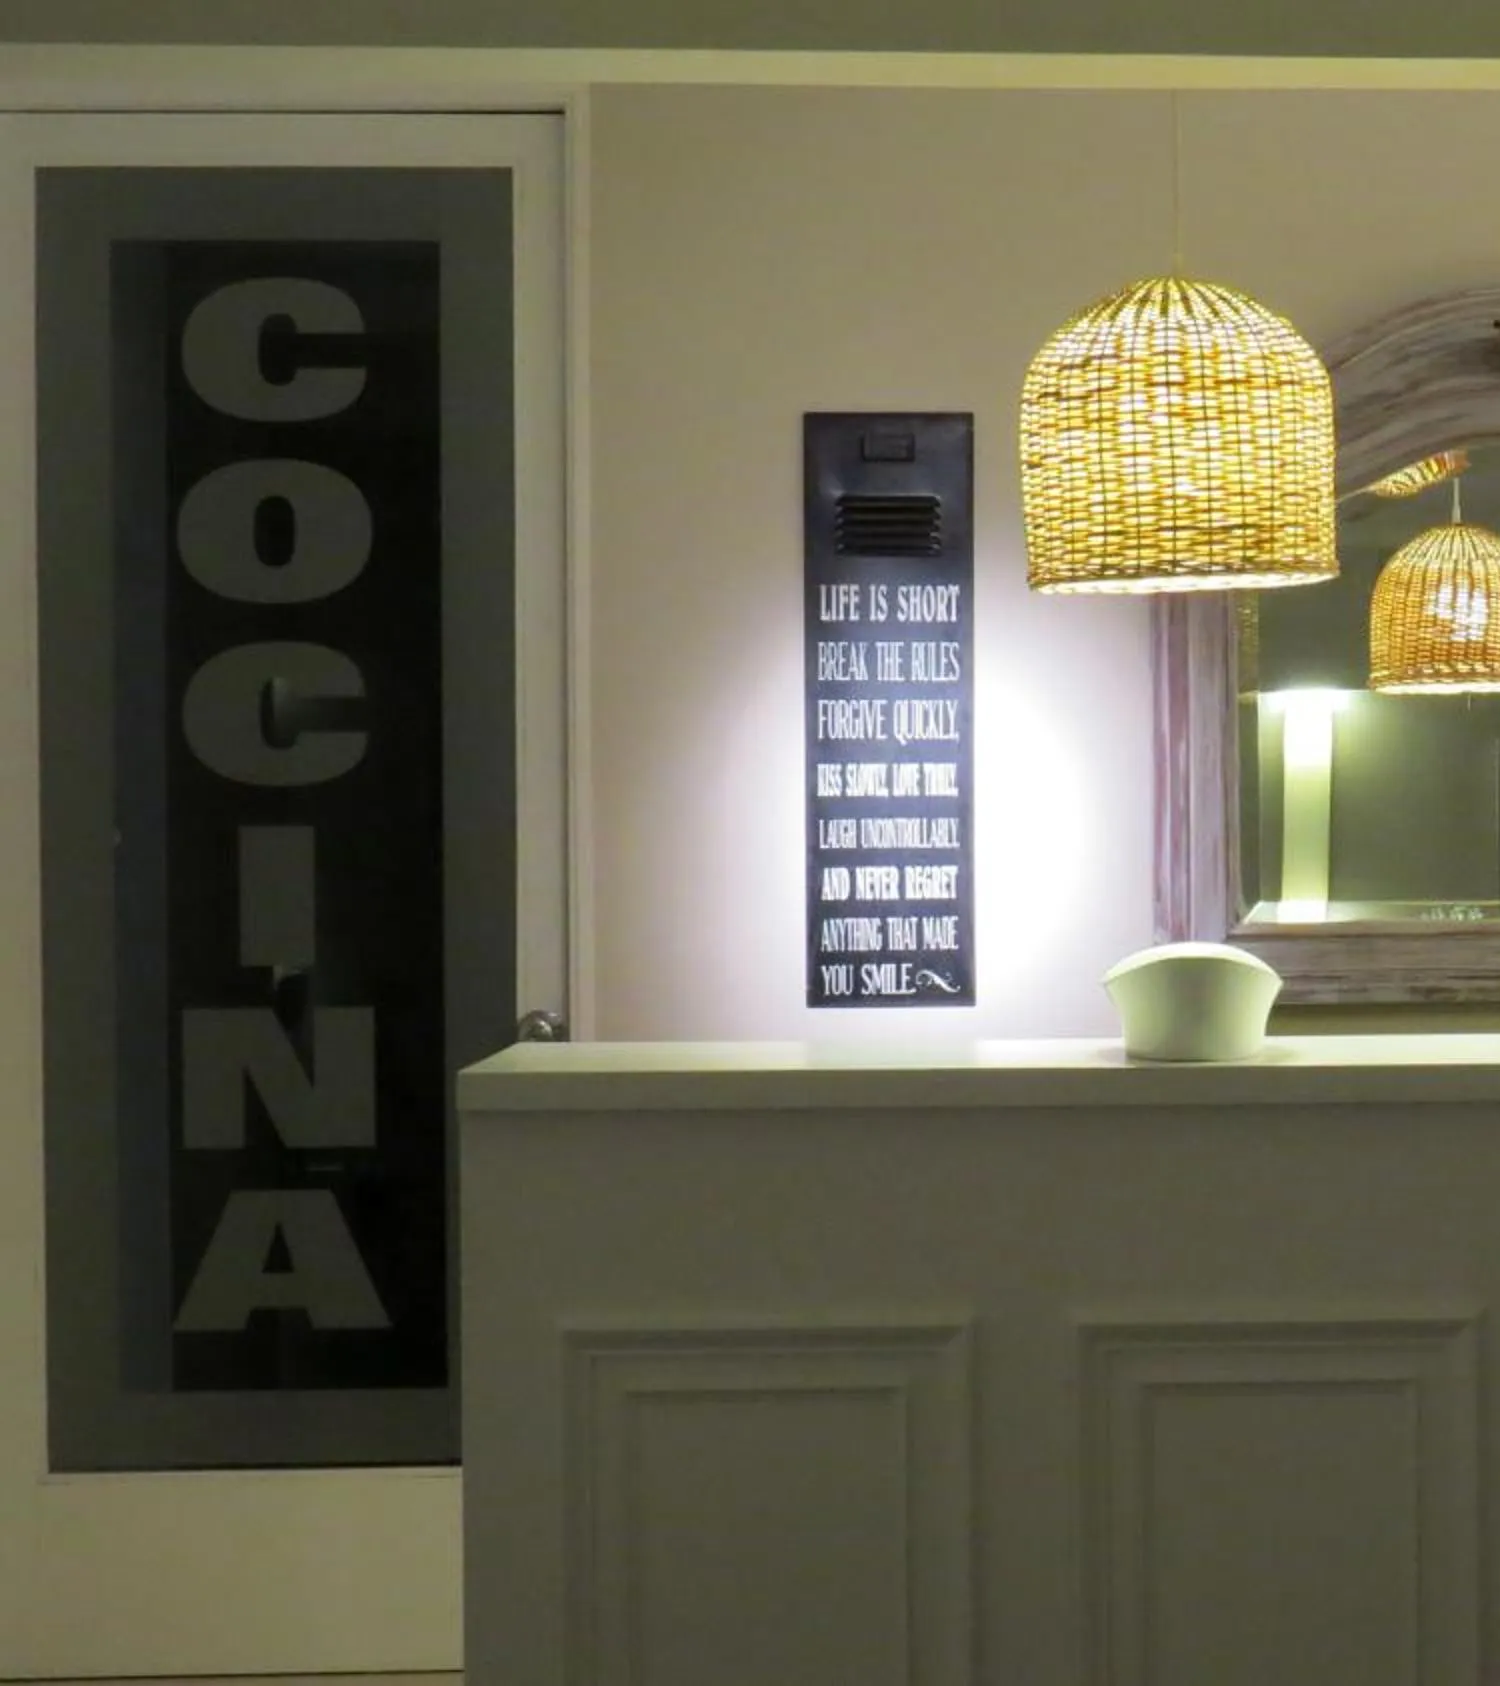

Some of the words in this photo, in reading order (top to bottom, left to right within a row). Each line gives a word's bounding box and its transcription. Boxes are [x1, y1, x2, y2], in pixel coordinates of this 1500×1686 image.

[820, 584, 861, 622] LIFE
[869, 584, 889, 622] IS
[897, 584, 961, 622] SHORT
[817, 641, 869, 681] BREAK
[875, 641, 905, 681] THE
[911, 641, 961, 681] RULES
[817, 699, 889, 740] FORGIVE
[177, 276, 394, 1332] COCINA
[819, 819, 857, 849] LAUGH
[821, 867, 850, 900] AND
[855, 866, 899, 900] NEVER
[904, 865, 959, 899] REGRET
[821, 918, 882, 951] ANYTHING
[886, 917, 919, 950] THAT
[923, 916, 959, 949] MADE
[821, 964, 854, 995] YOU
